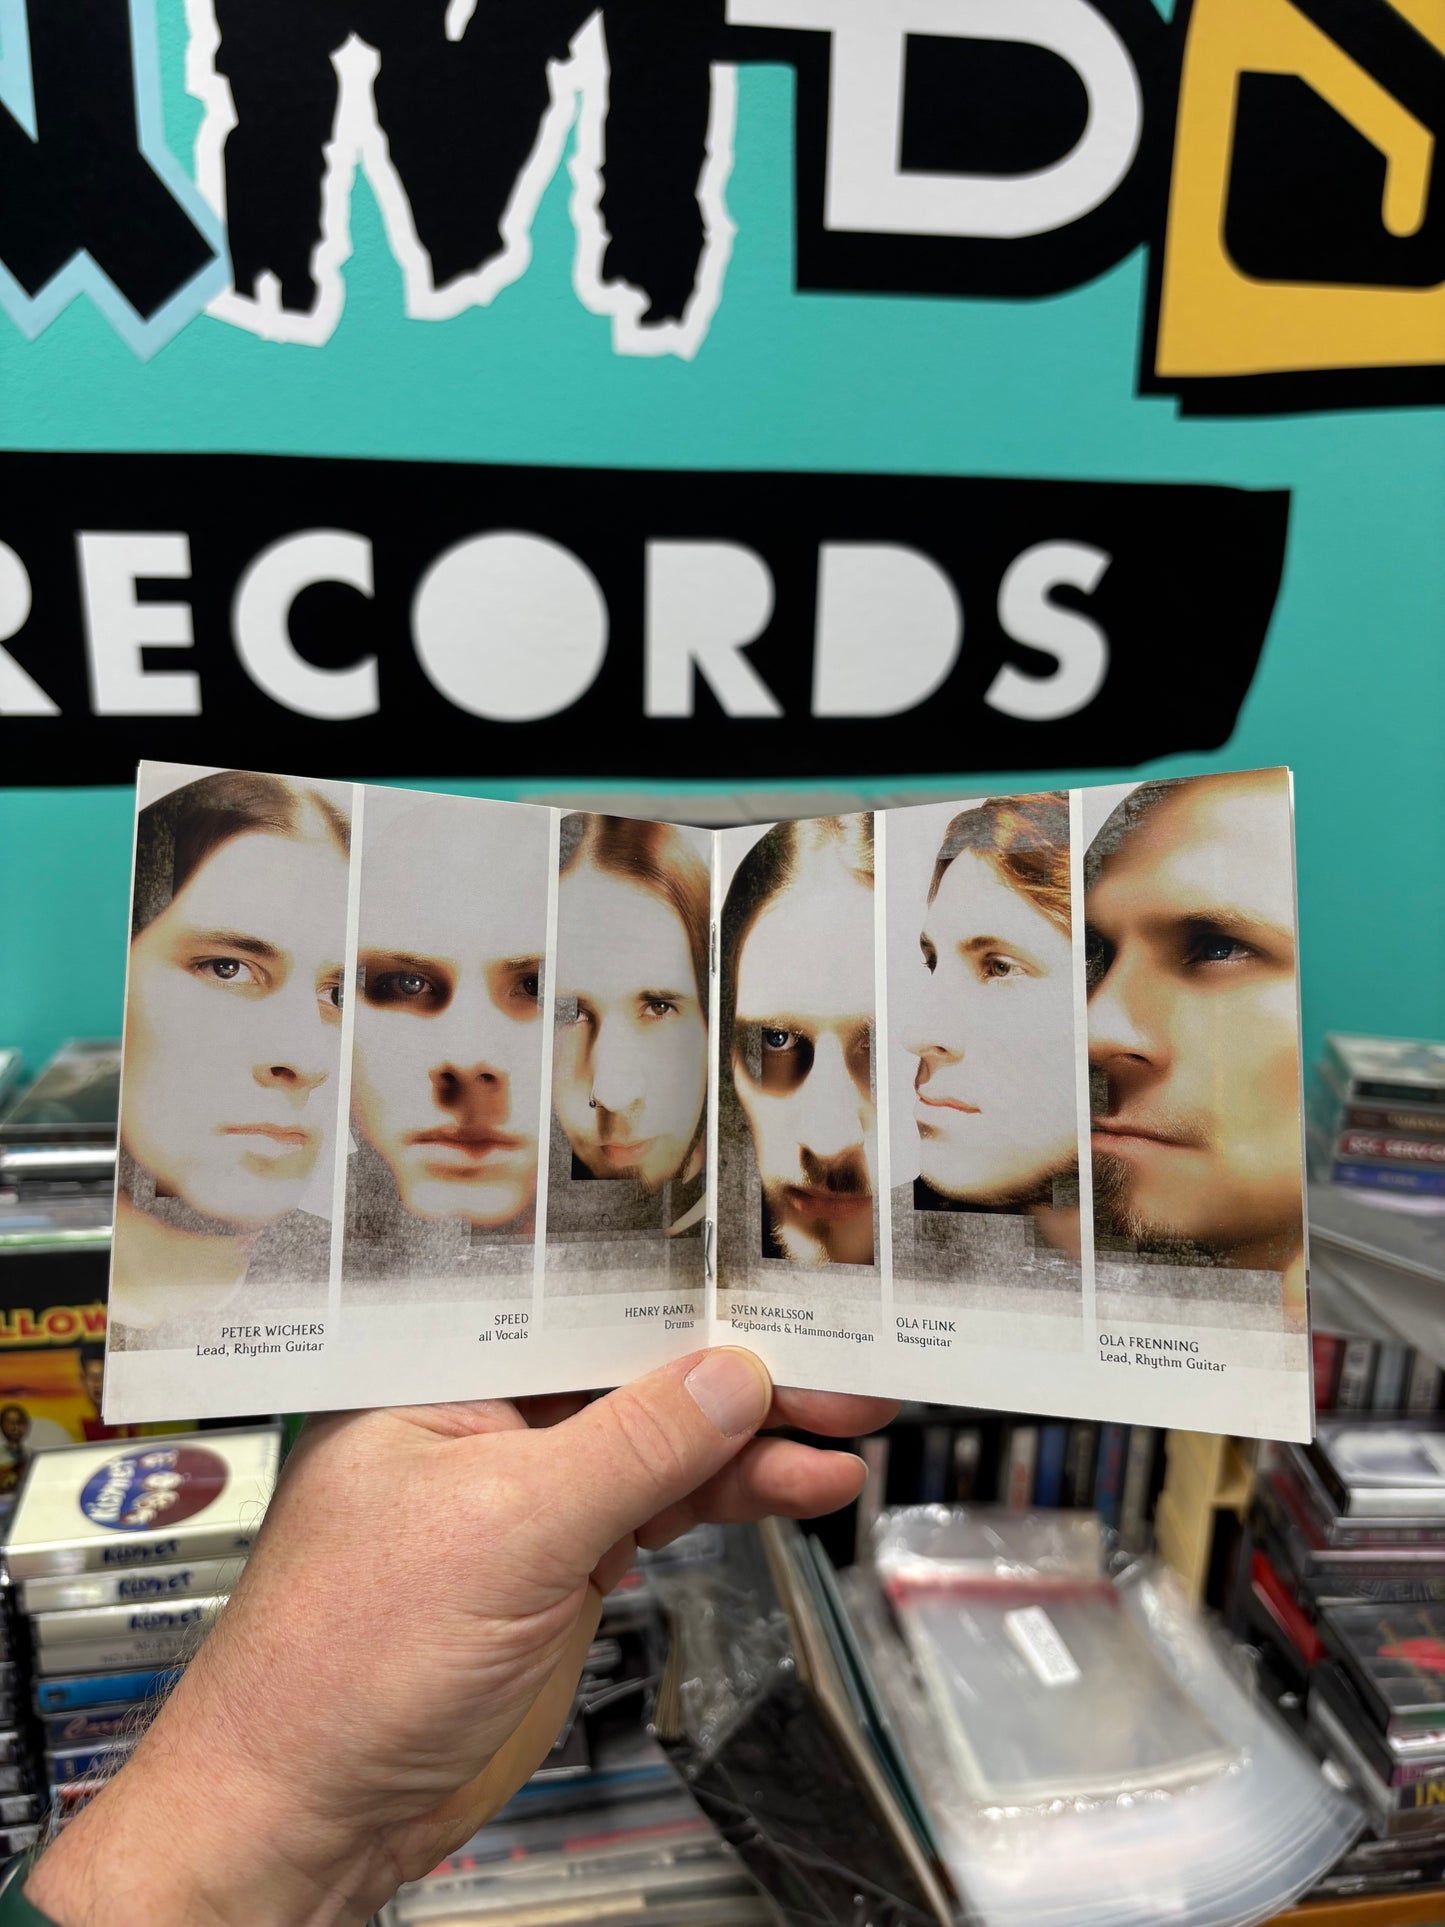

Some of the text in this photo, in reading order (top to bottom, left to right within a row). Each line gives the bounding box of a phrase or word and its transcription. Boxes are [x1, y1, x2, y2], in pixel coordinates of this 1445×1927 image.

[494, 1313, 529, 1325] SPEED
[624, 1304, 695, 1318] HENRY RANTA
[730, 1304, 814, 1321] SVEN KARLSSON
[221, 1323, 325, 1338] PETER WICHERS
[664, 1319, 694, 1330] Drums
[731, 1318, 874, 1344] Keyboards & Hammondorgan
[896, 1316, 956, 1333] OLA FLINK
[478, 1329, 528, 1341] all Vocals
[897, 1332, 952, 1348] Bassguitar
[196, 1340, 325, 1357] Lead, Rhythm Guitar
[1099, 1334, 1199, 1353] OLA FRENNING
[1100, 1350, 1227, 1372] Lead, Rhythm Guitar
